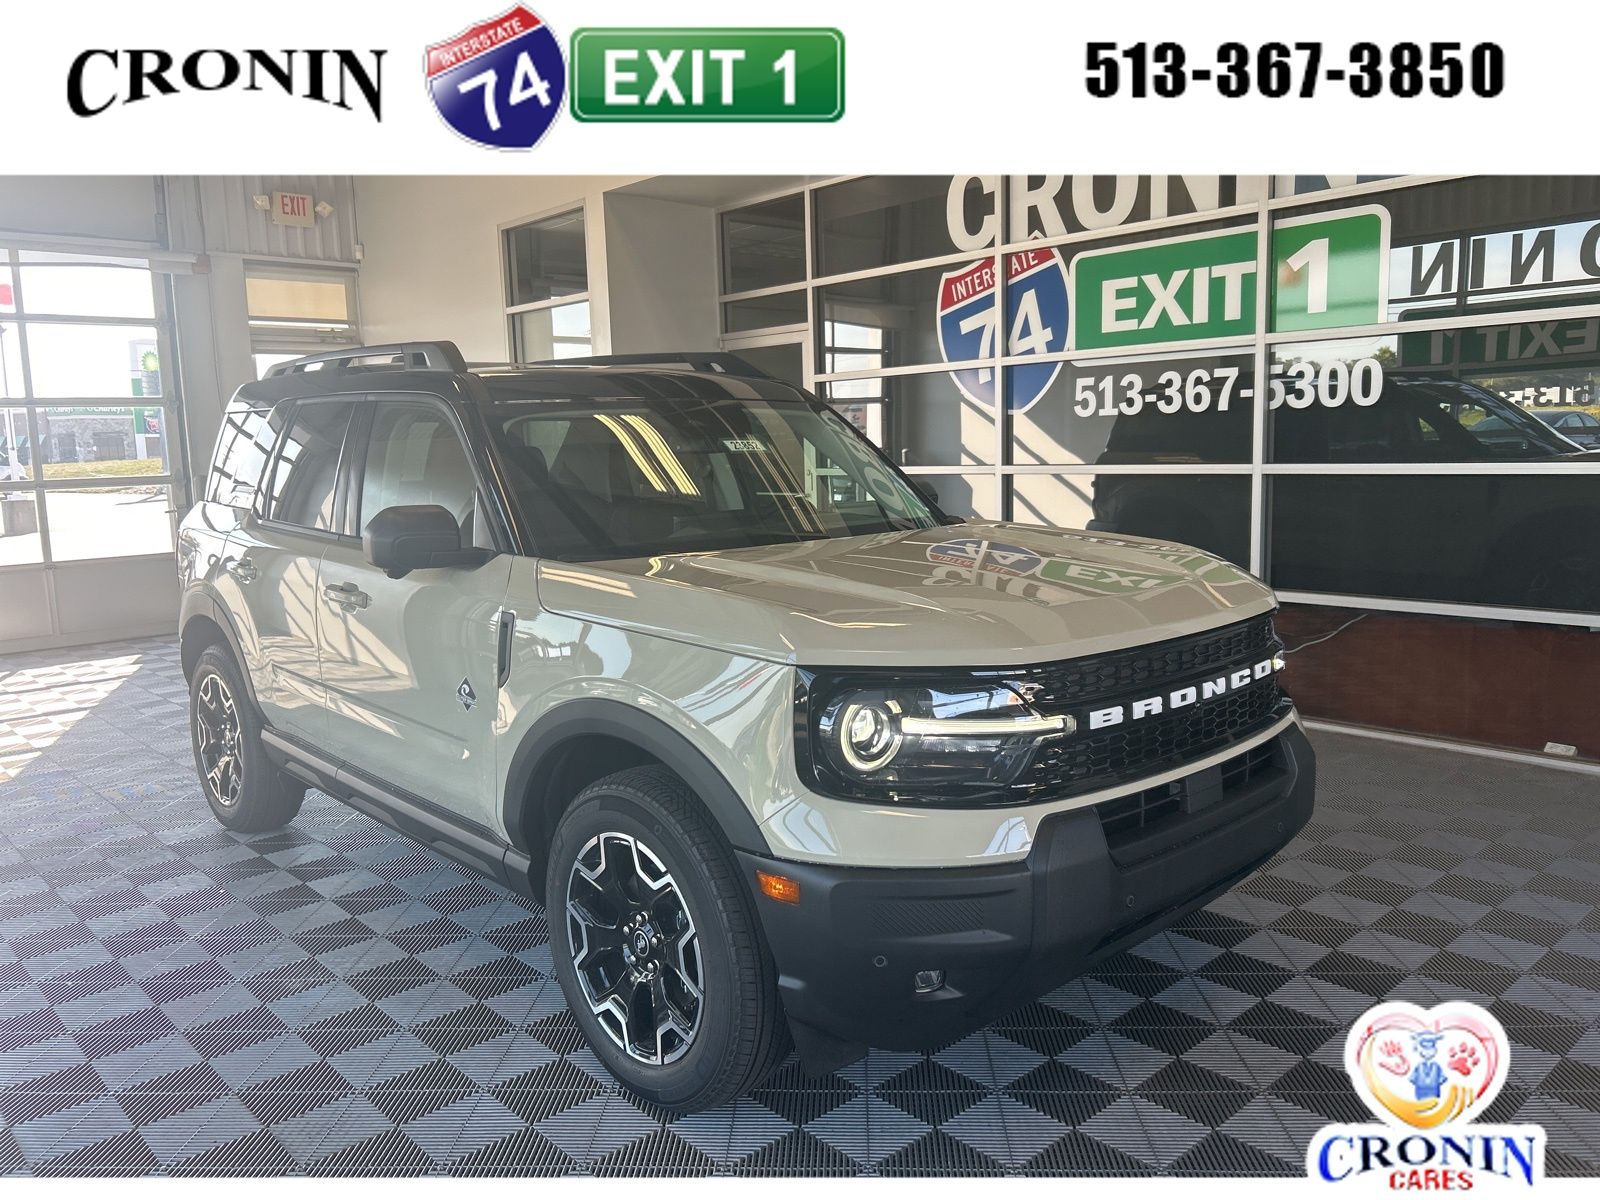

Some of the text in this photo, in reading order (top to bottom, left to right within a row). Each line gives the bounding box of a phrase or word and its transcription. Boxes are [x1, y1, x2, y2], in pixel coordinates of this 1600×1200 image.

[281, 194, 307, 216] EXIT
[951, 250, 1039, 302] INTERSATE
[1101, 236, 1330, 334] EXIT 1
[959, 288, 1054, 385] 74
[1073, 357, 1384, 418] 513-367-5300
[1089, 658, 1272, 730] BRONCO
